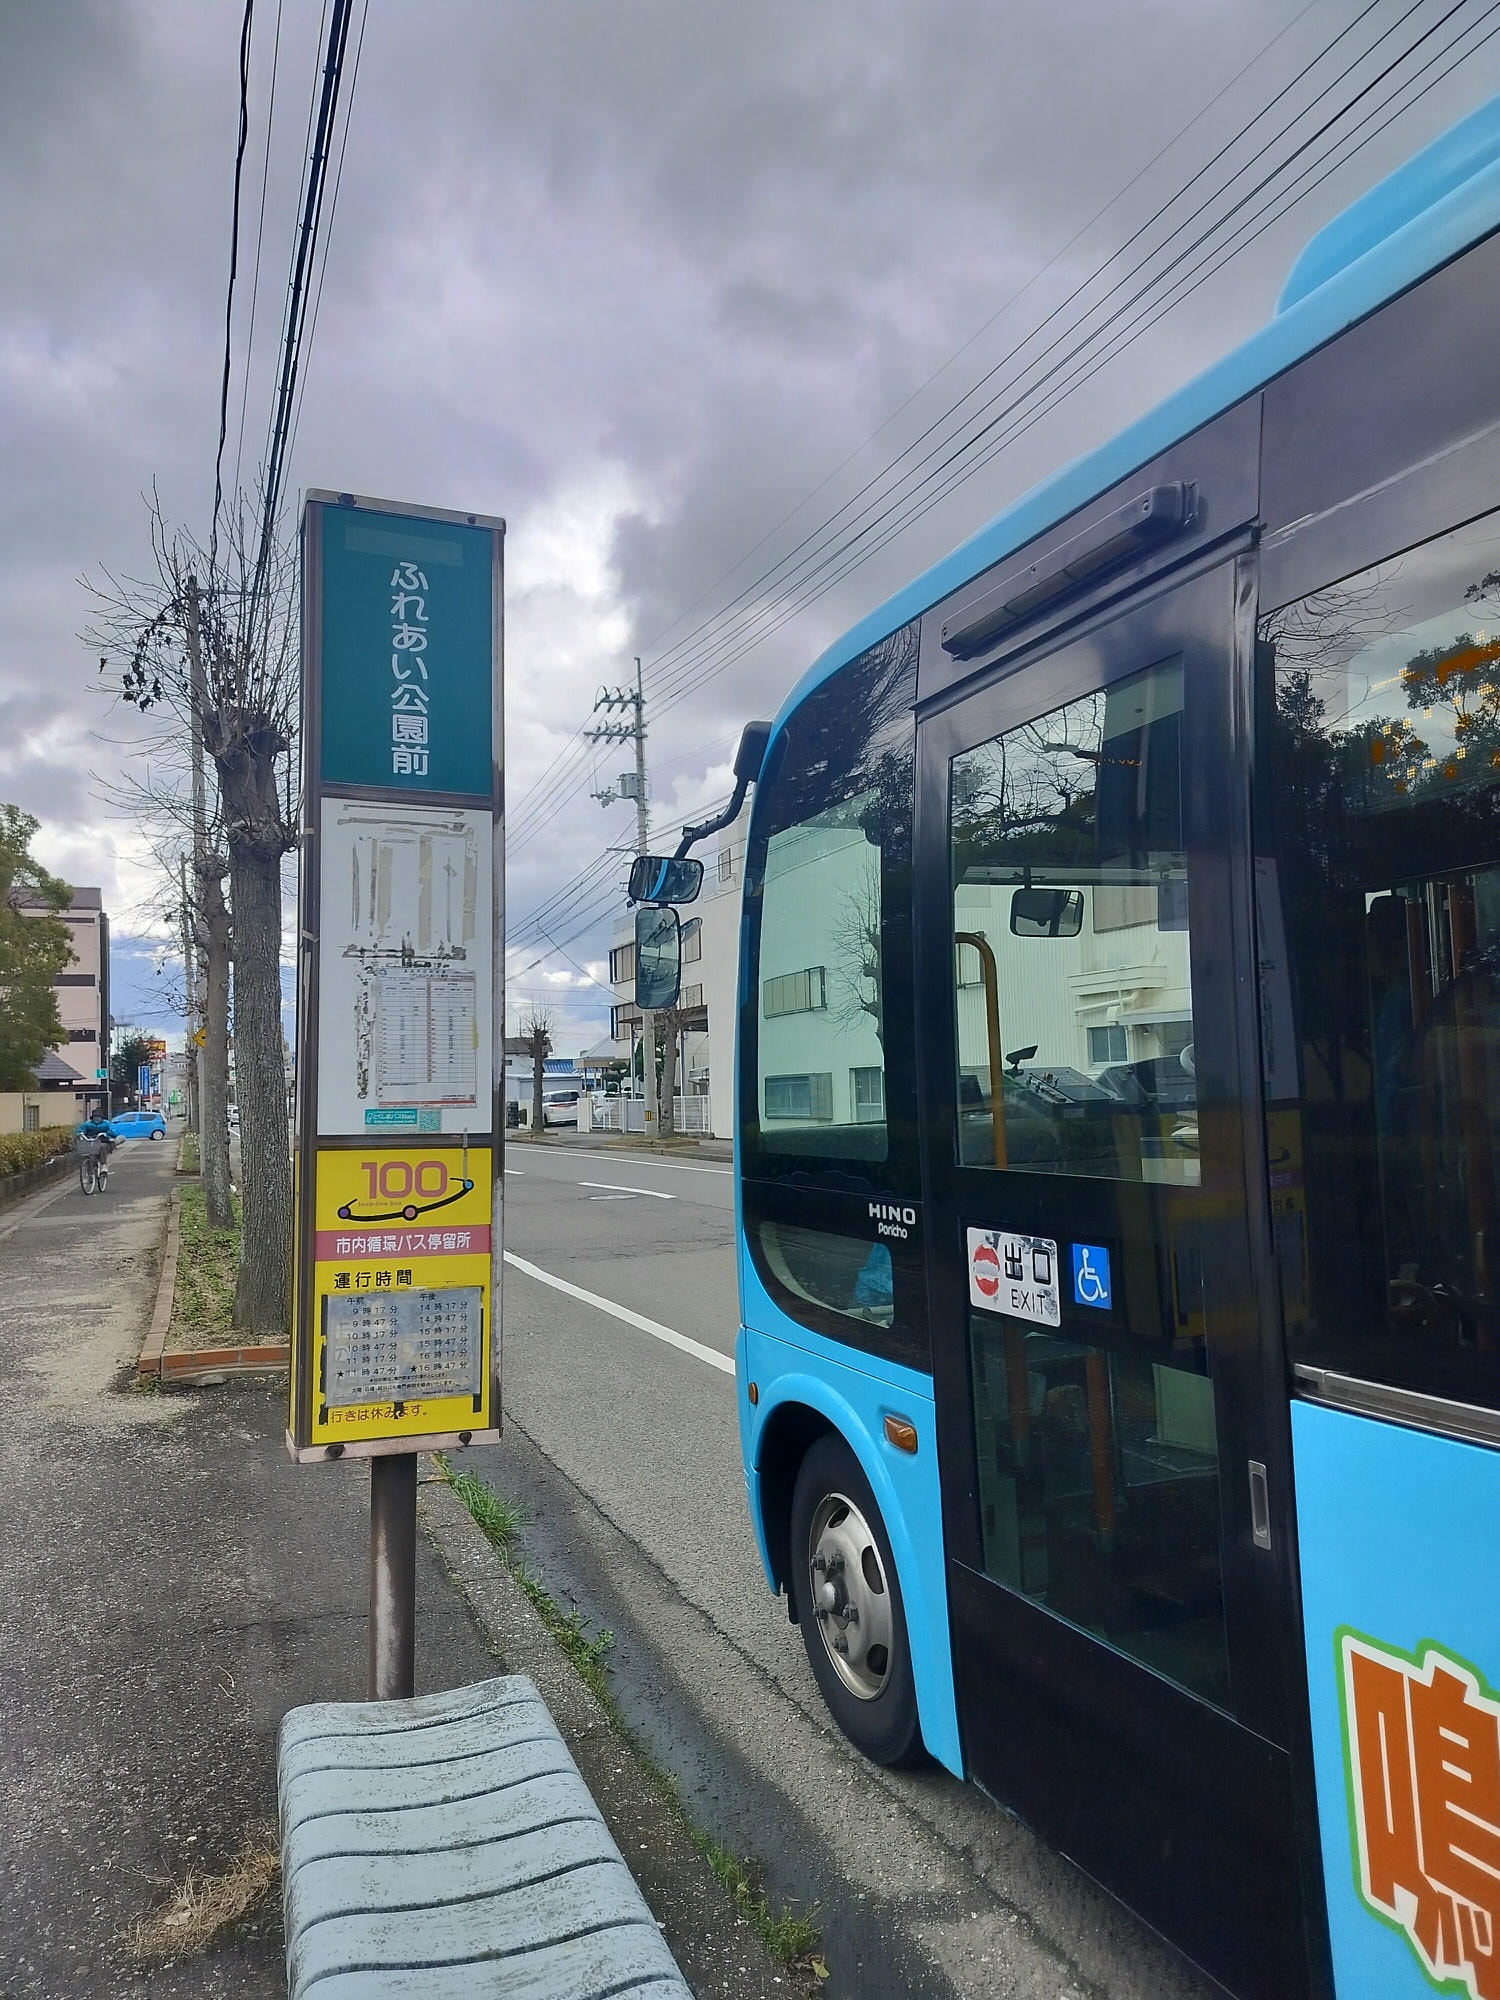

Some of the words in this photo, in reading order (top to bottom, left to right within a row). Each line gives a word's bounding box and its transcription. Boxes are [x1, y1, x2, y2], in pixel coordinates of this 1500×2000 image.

[391, 562, 429, 775] ふれあい公園前
[361, 1161, 447, 1199] 100
[868, 1202, 916, 1225] HINO
[336, 1232, 471, 1254] 市内循環バス停留所
[1004, 1241, 1051, 1285] 出口
[334, 1270, 412, 1289] 運行時間
[1011, 1288, 1046, 1315] EXIT
